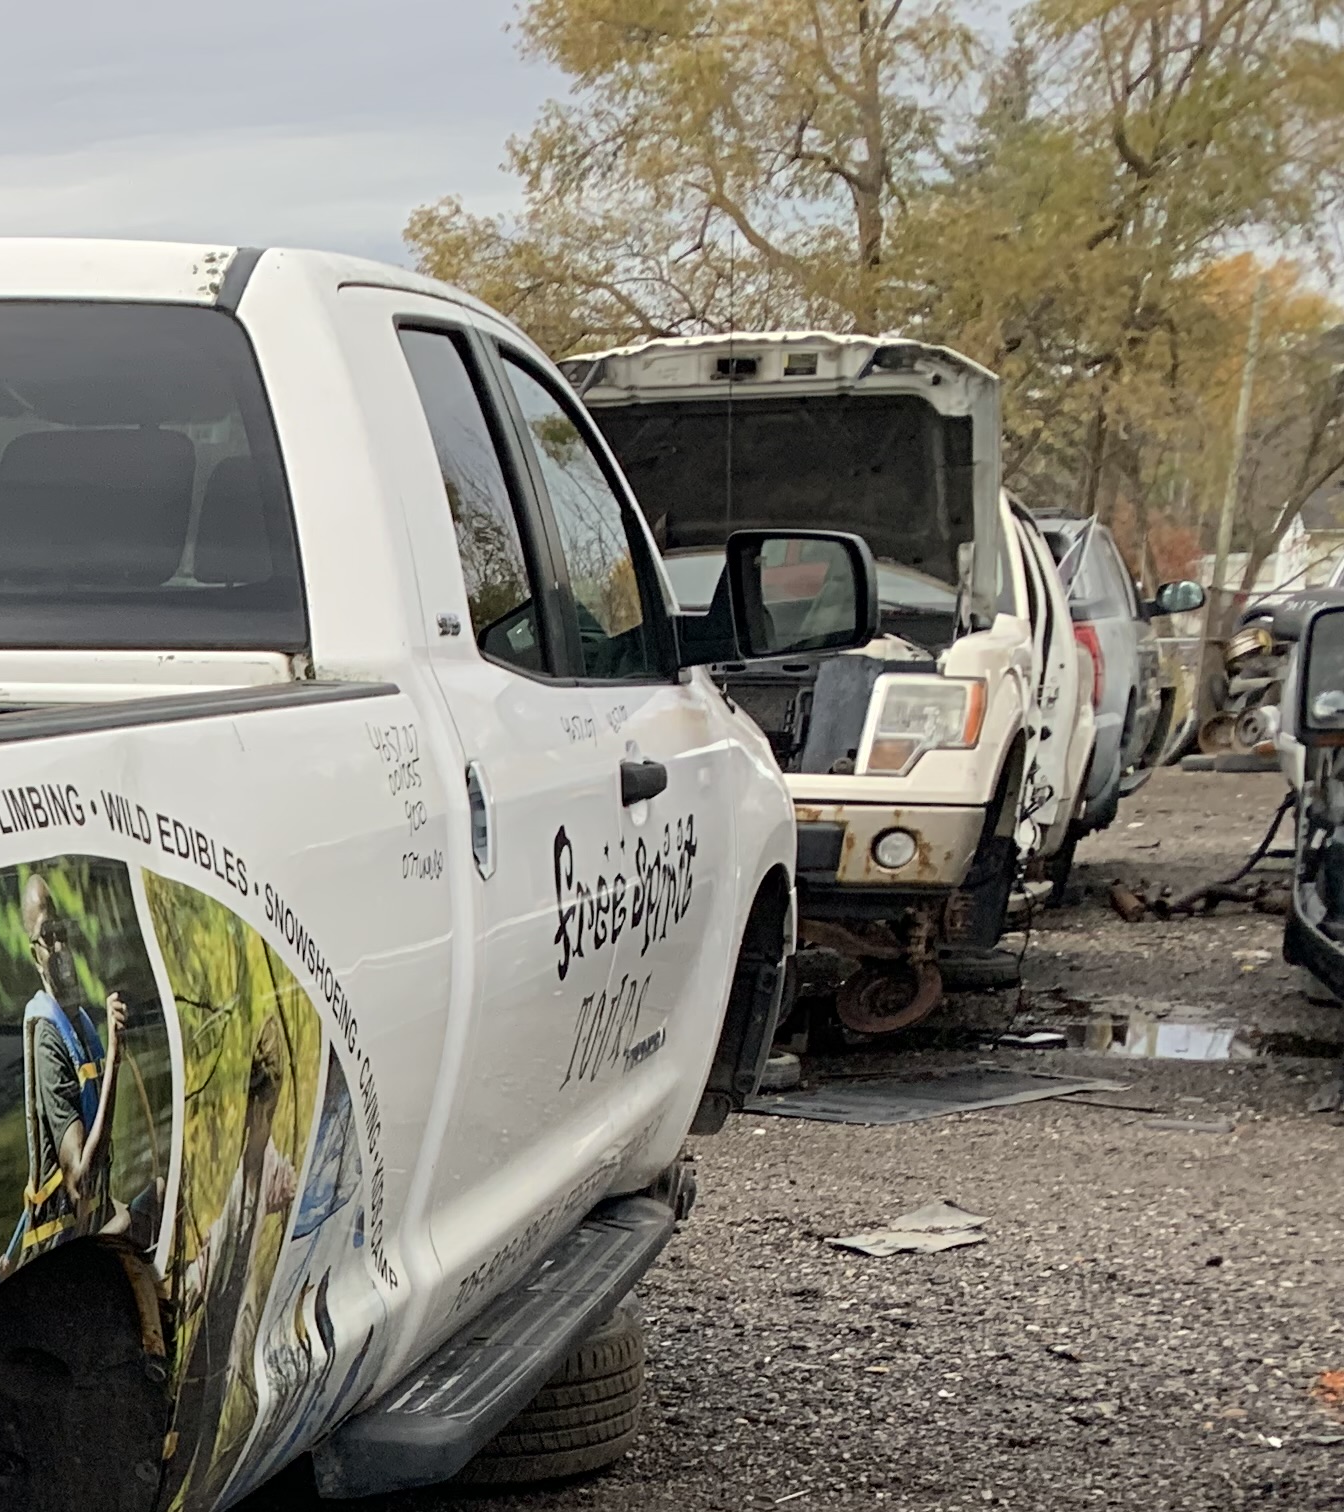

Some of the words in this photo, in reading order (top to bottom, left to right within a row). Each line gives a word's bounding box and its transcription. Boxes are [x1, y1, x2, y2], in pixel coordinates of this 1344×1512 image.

[100, 789, 152, 845] WILD
[156, 812, 248, 897] EDIBLES
[265, 883, 358, 1054] SNOWSHOEING
[359, 1056, 381, 1154] CAVING
[371, 1218, 398, 1290] CAMP
